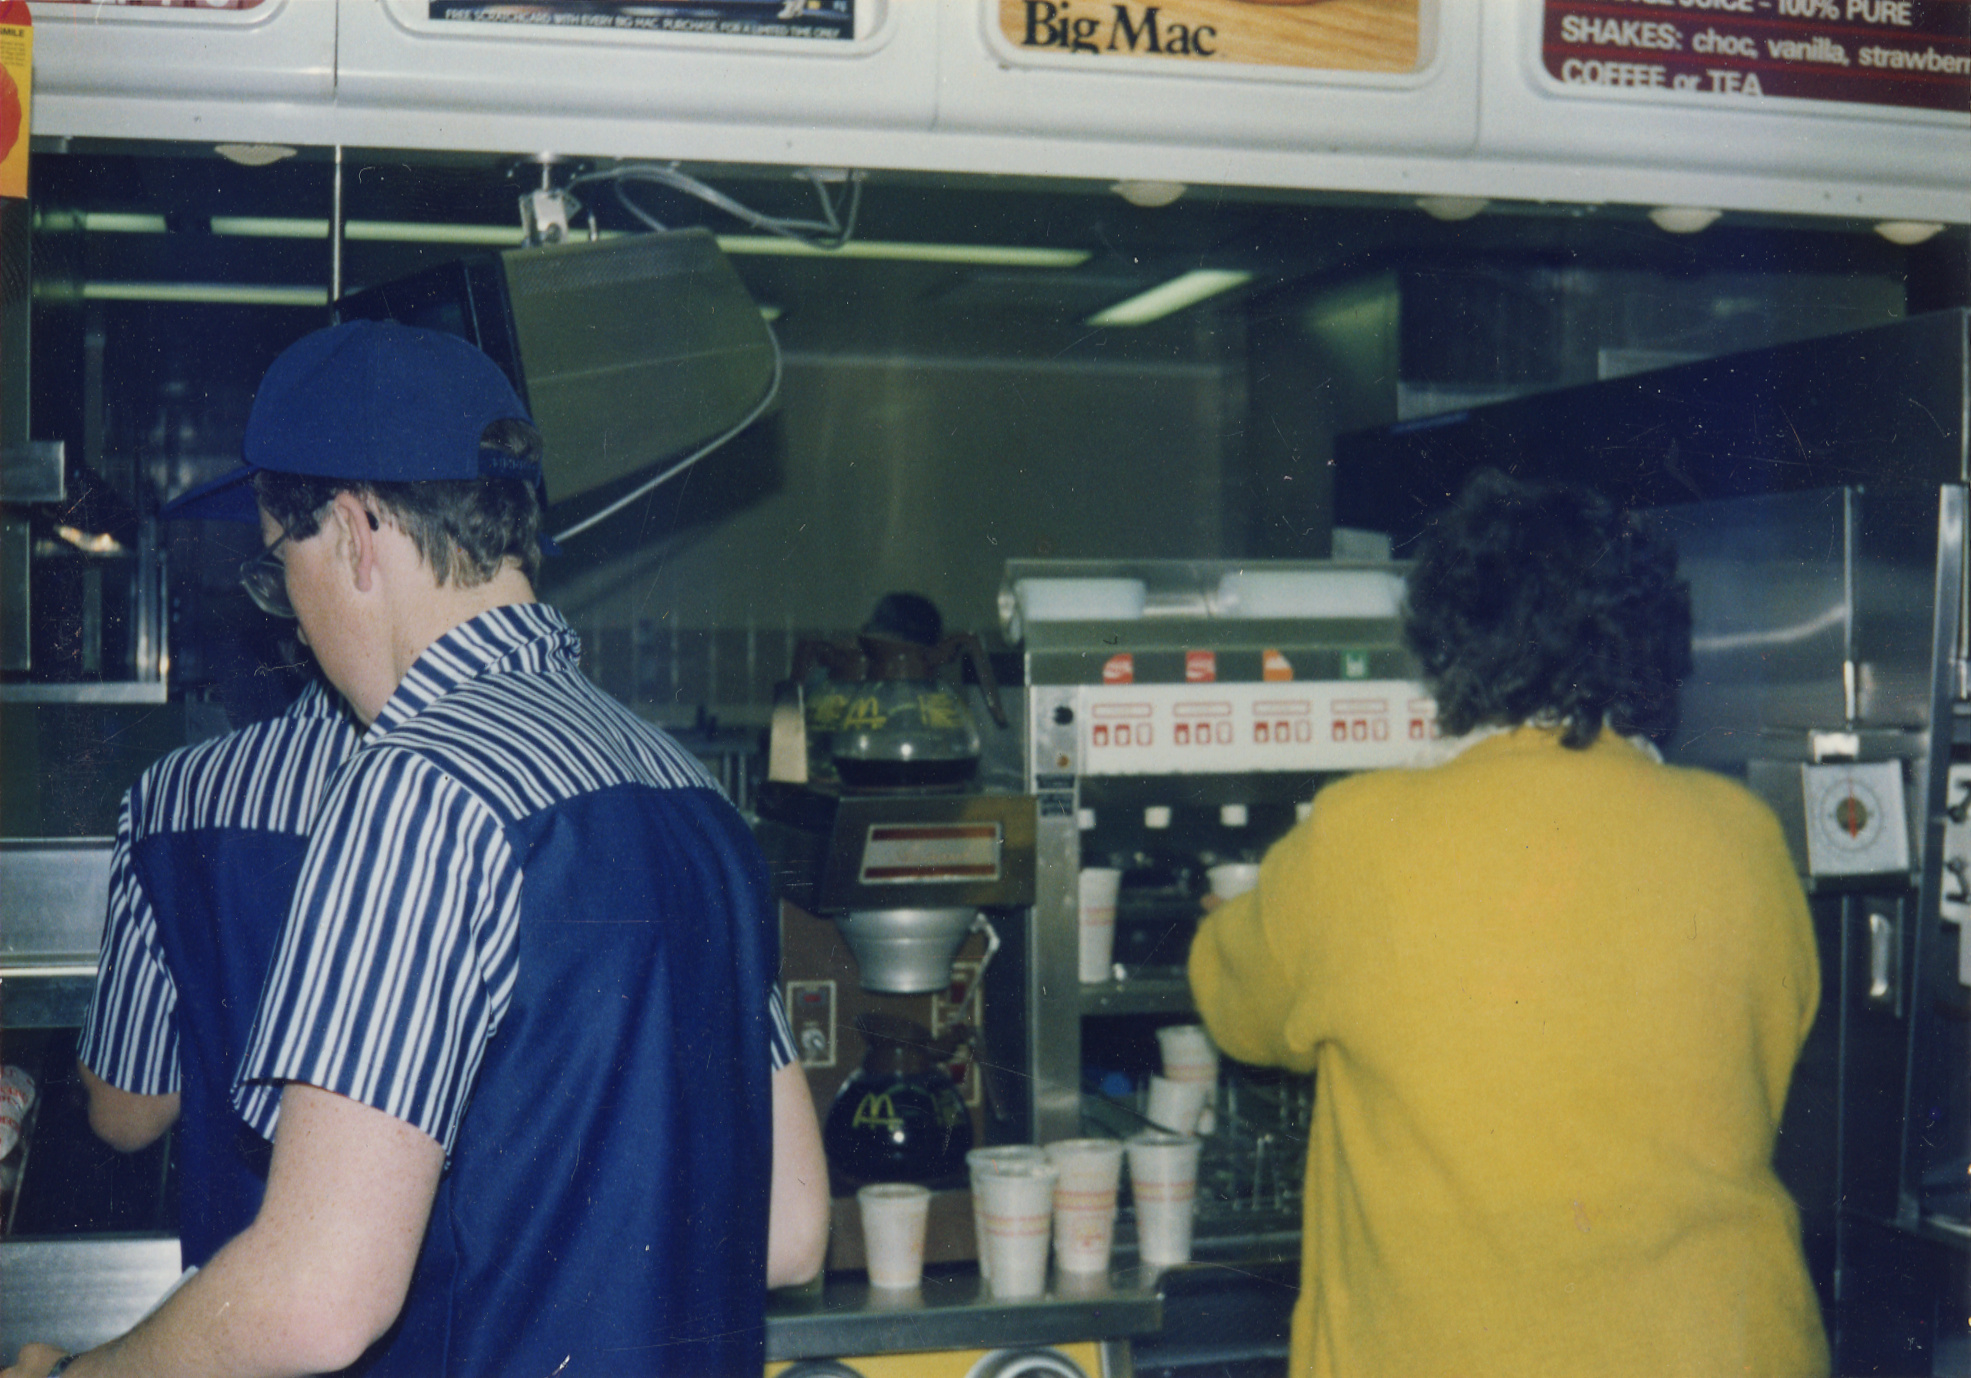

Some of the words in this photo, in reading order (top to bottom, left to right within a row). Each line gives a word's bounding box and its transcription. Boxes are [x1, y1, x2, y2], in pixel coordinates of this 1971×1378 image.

[1021, 0, 1100, 54] Big
[1107, 4, 1217, 56] Mac
[1778, 0, 1840, 20] 100%
[1846, 0, 1912, 26] PURE
[1561, 14, 1684, 50] SHAKES:
[1767, 36, 1850, 67] vanilla,
[1561, 58, 1666, 88] COFFEE
[1673, 74, 1702, 91] or
[1706, 69, 1764, 96] TEA
